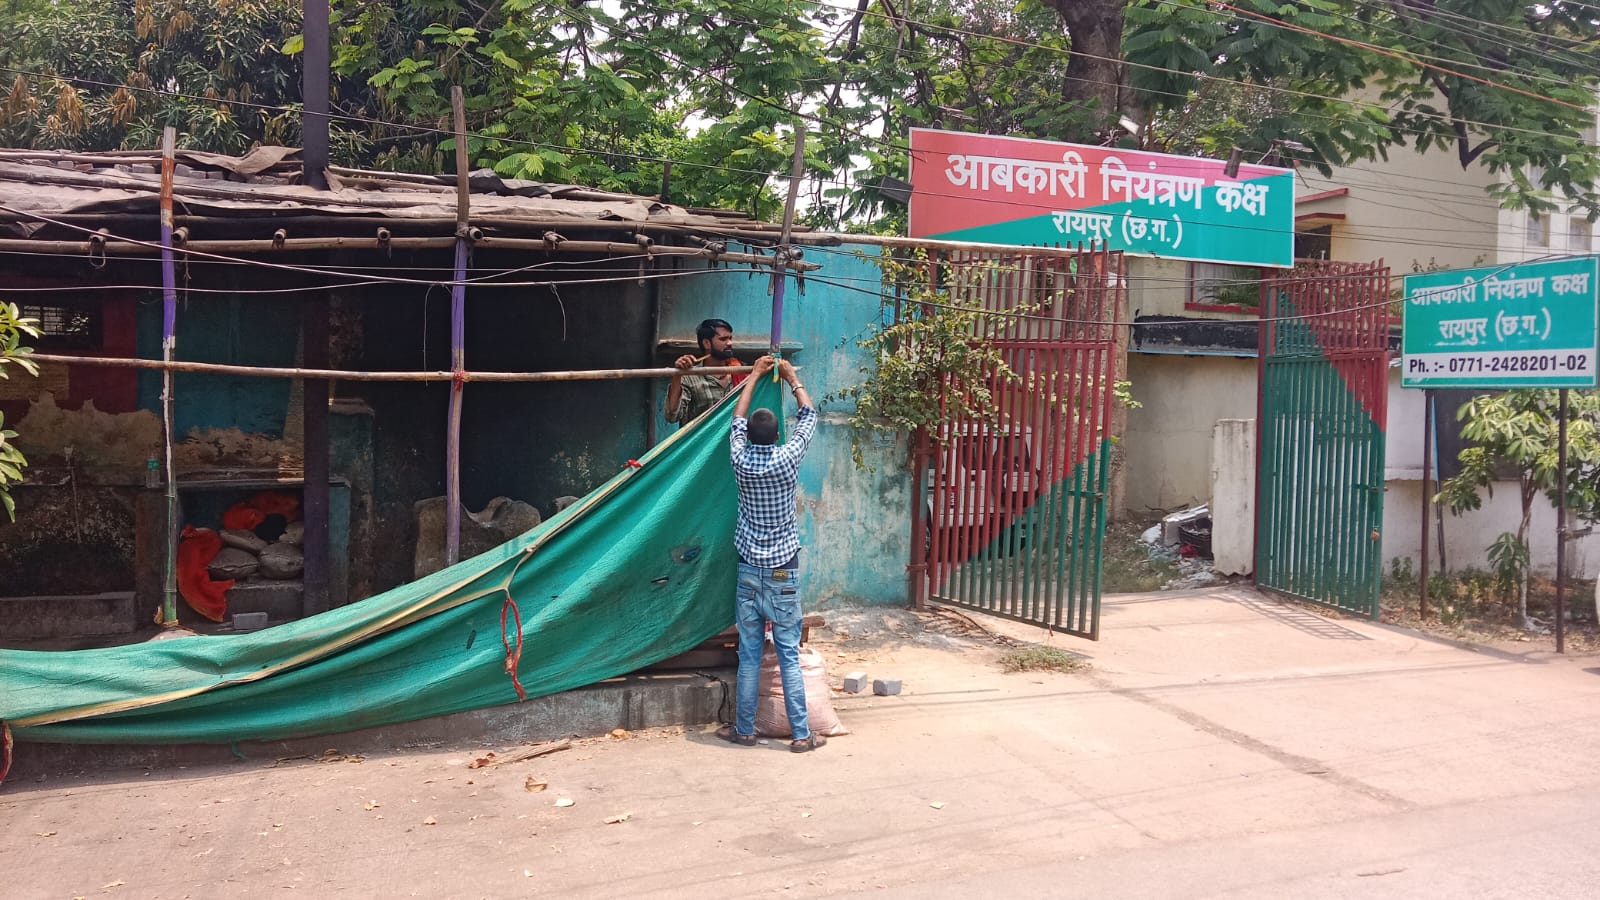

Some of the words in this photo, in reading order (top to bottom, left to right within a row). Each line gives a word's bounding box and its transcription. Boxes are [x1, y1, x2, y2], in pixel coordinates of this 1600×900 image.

[945, 150, 1088, 198] आबकारी
[1099, 156, 1205, 209] नियंत्रण
[1214, 178, 1269, 216] कक्ष
[1051, 211, 1114, 243] रायपुर
[1121, 209, 1183, 249] (छ.ग.)
[1411, 276, 1478, 306] आबकारी
[1483, 272, 1545, 301] नियंत्रण
[1551, 273, 1590, 296] कक्ष
[1438, 318, 1488, 345] रायपुर
[1495, 307, 1552, 342] (छ.ग.)
[1449, 355, 1587, 373] 0771-2428201-02
